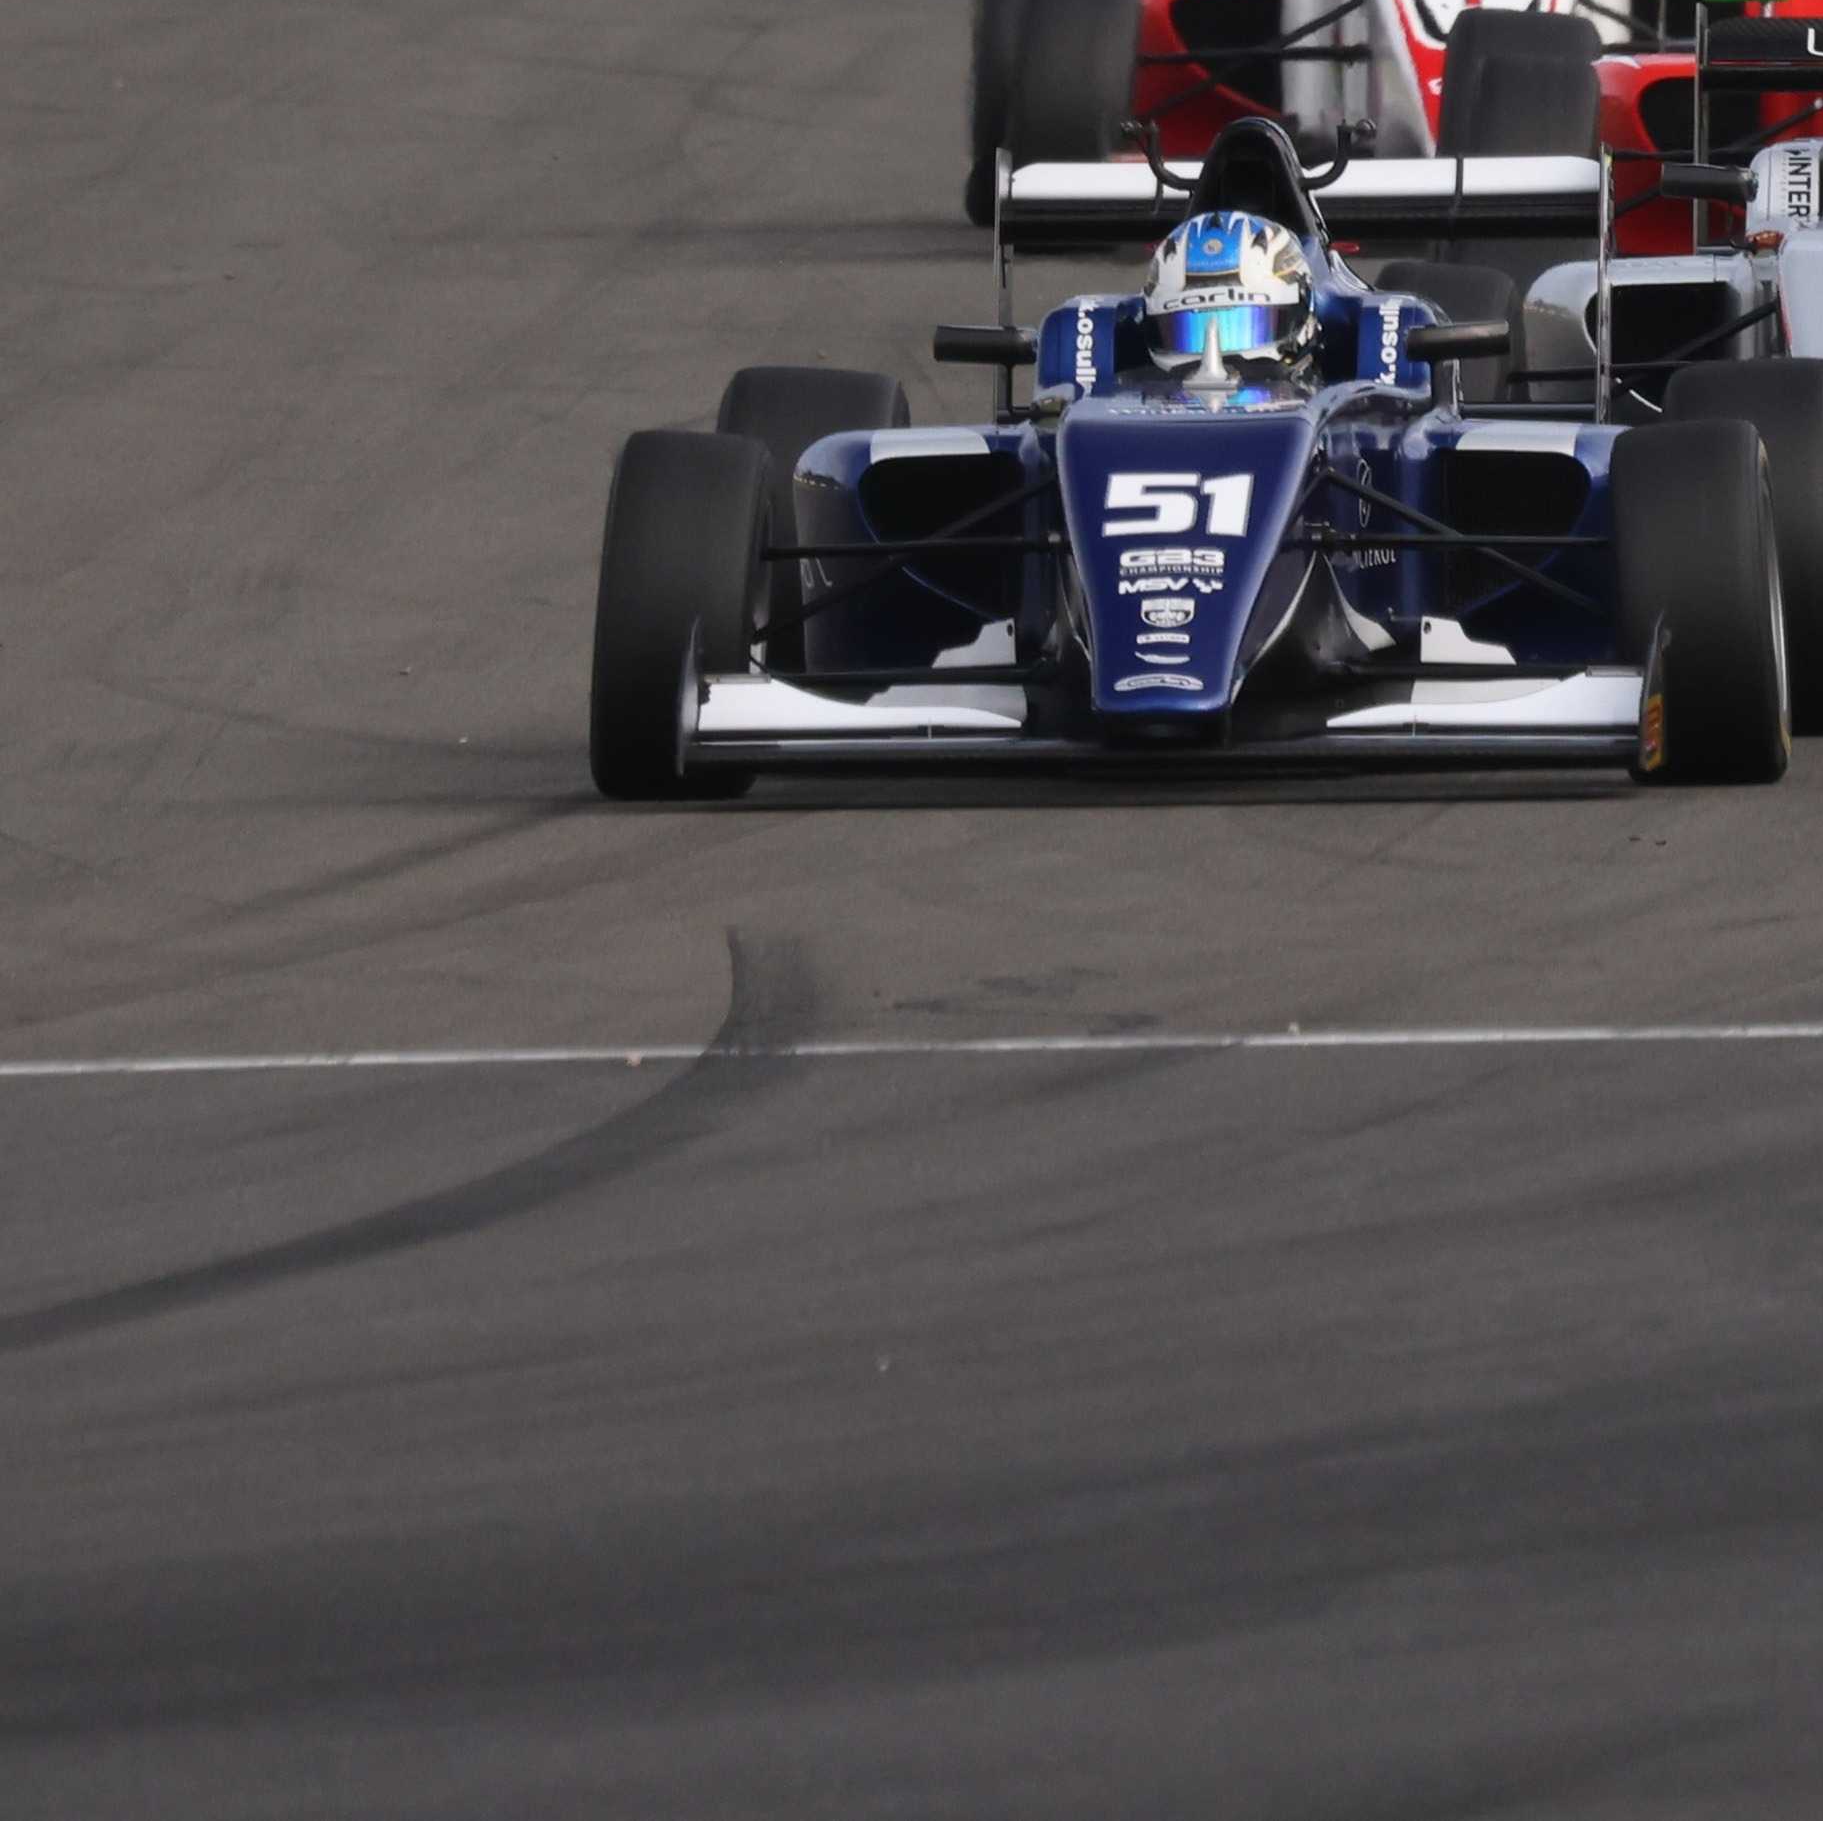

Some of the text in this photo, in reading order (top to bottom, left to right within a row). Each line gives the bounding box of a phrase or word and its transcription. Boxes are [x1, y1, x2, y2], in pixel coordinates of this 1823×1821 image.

[1162, 287, 1271, 311] carlin
[1102, 472, 1255, 538] 51
[1119, 549, 1226, 567] GB3
[1118, 577, 1189, 595] MSV
